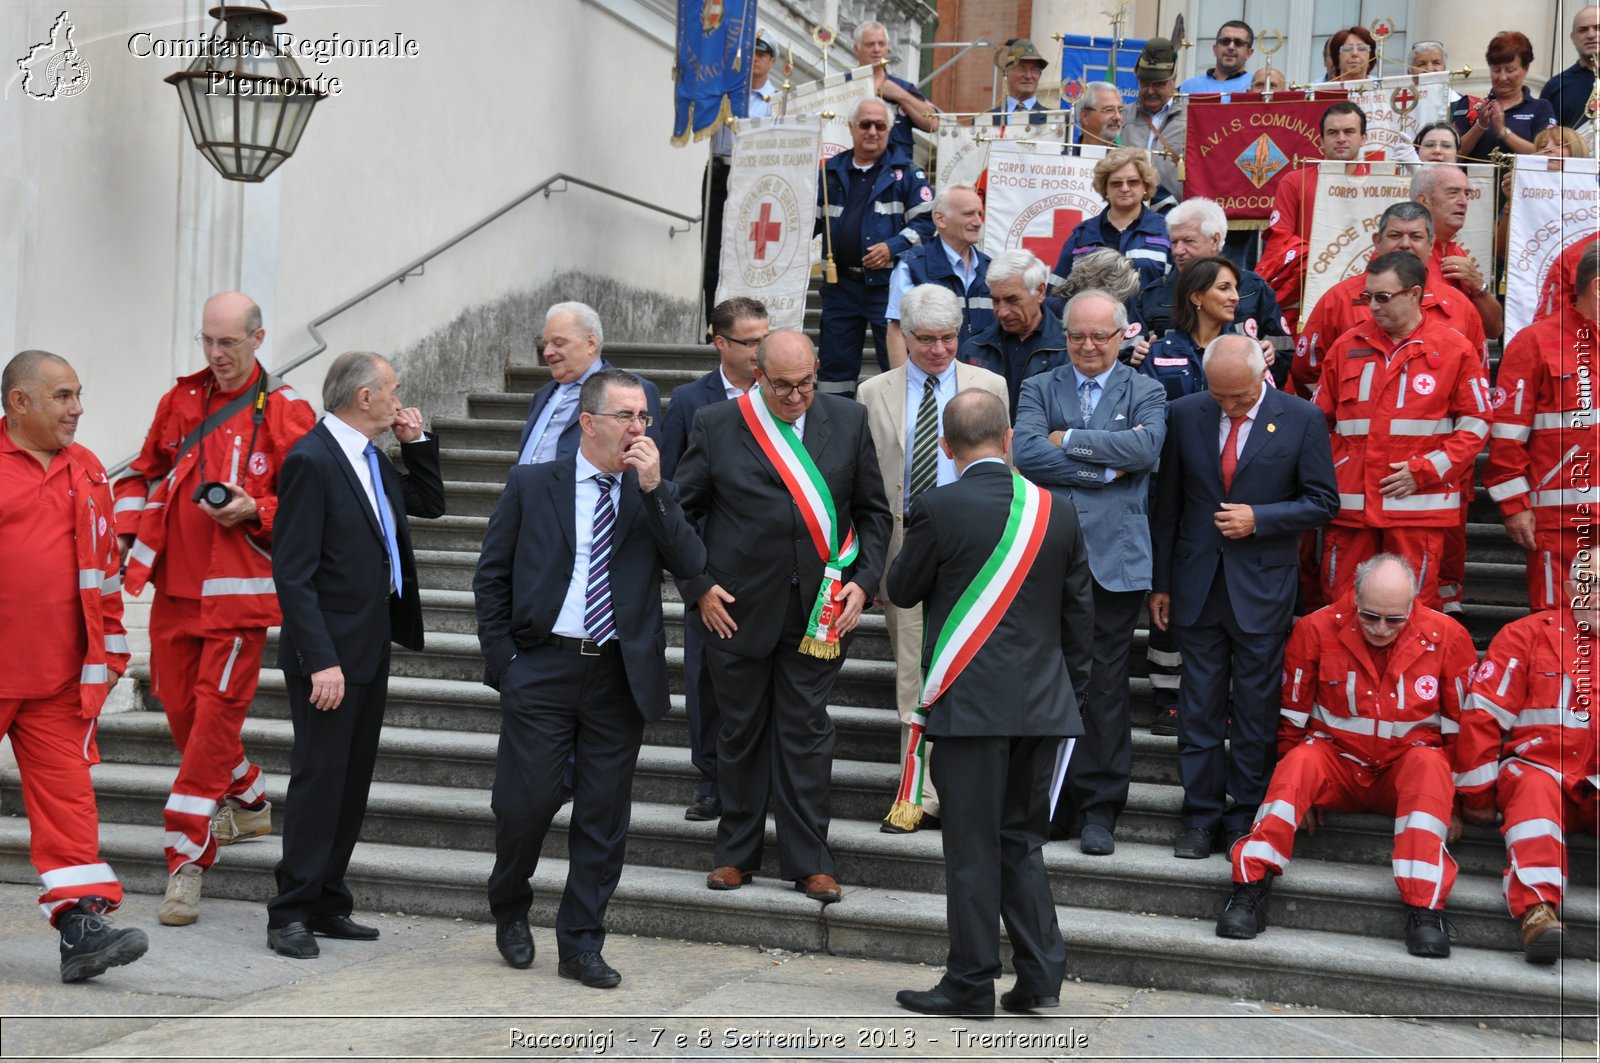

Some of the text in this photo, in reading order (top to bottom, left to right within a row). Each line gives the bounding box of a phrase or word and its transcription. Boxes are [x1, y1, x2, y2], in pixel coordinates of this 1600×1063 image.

[998, 161, 1025, 174] CORPO
[1029, 164, 1075, 177] VOLONTARI
[989, 174, 1037, 189] CROCE
[1040, 177, 1085, 192] ROSSA
[1328, 185, 1358, 199] CORPO
[1521, 187, 1555, 200] CORPO
[1010, 195, 1075, 238] CONVENZIONE
[1312, 226, 1360, 275] CROCE
[1517, 219, 1561, 273] CROCE
